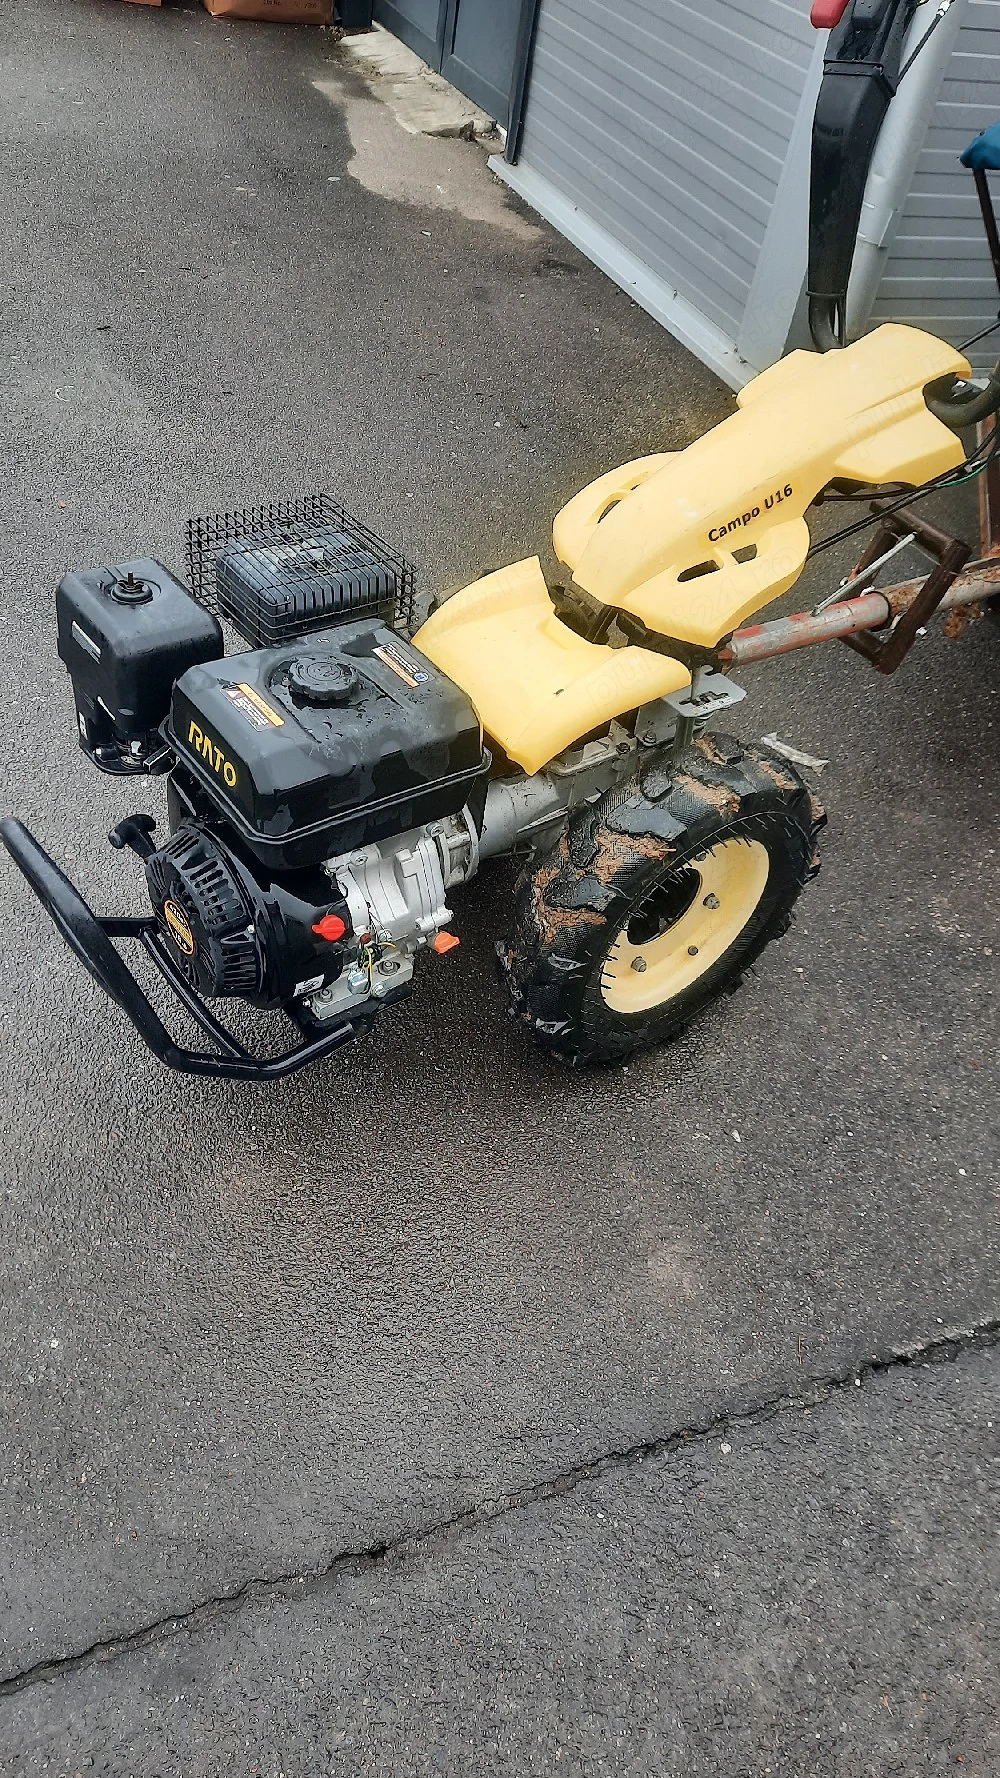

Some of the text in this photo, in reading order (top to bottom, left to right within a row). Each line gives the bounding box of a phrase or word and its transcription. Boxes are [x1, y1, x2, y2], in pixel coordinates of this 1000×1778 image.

[708, 484, 793, 541] Campo U16
[188, 720, 237, 787] RATO
